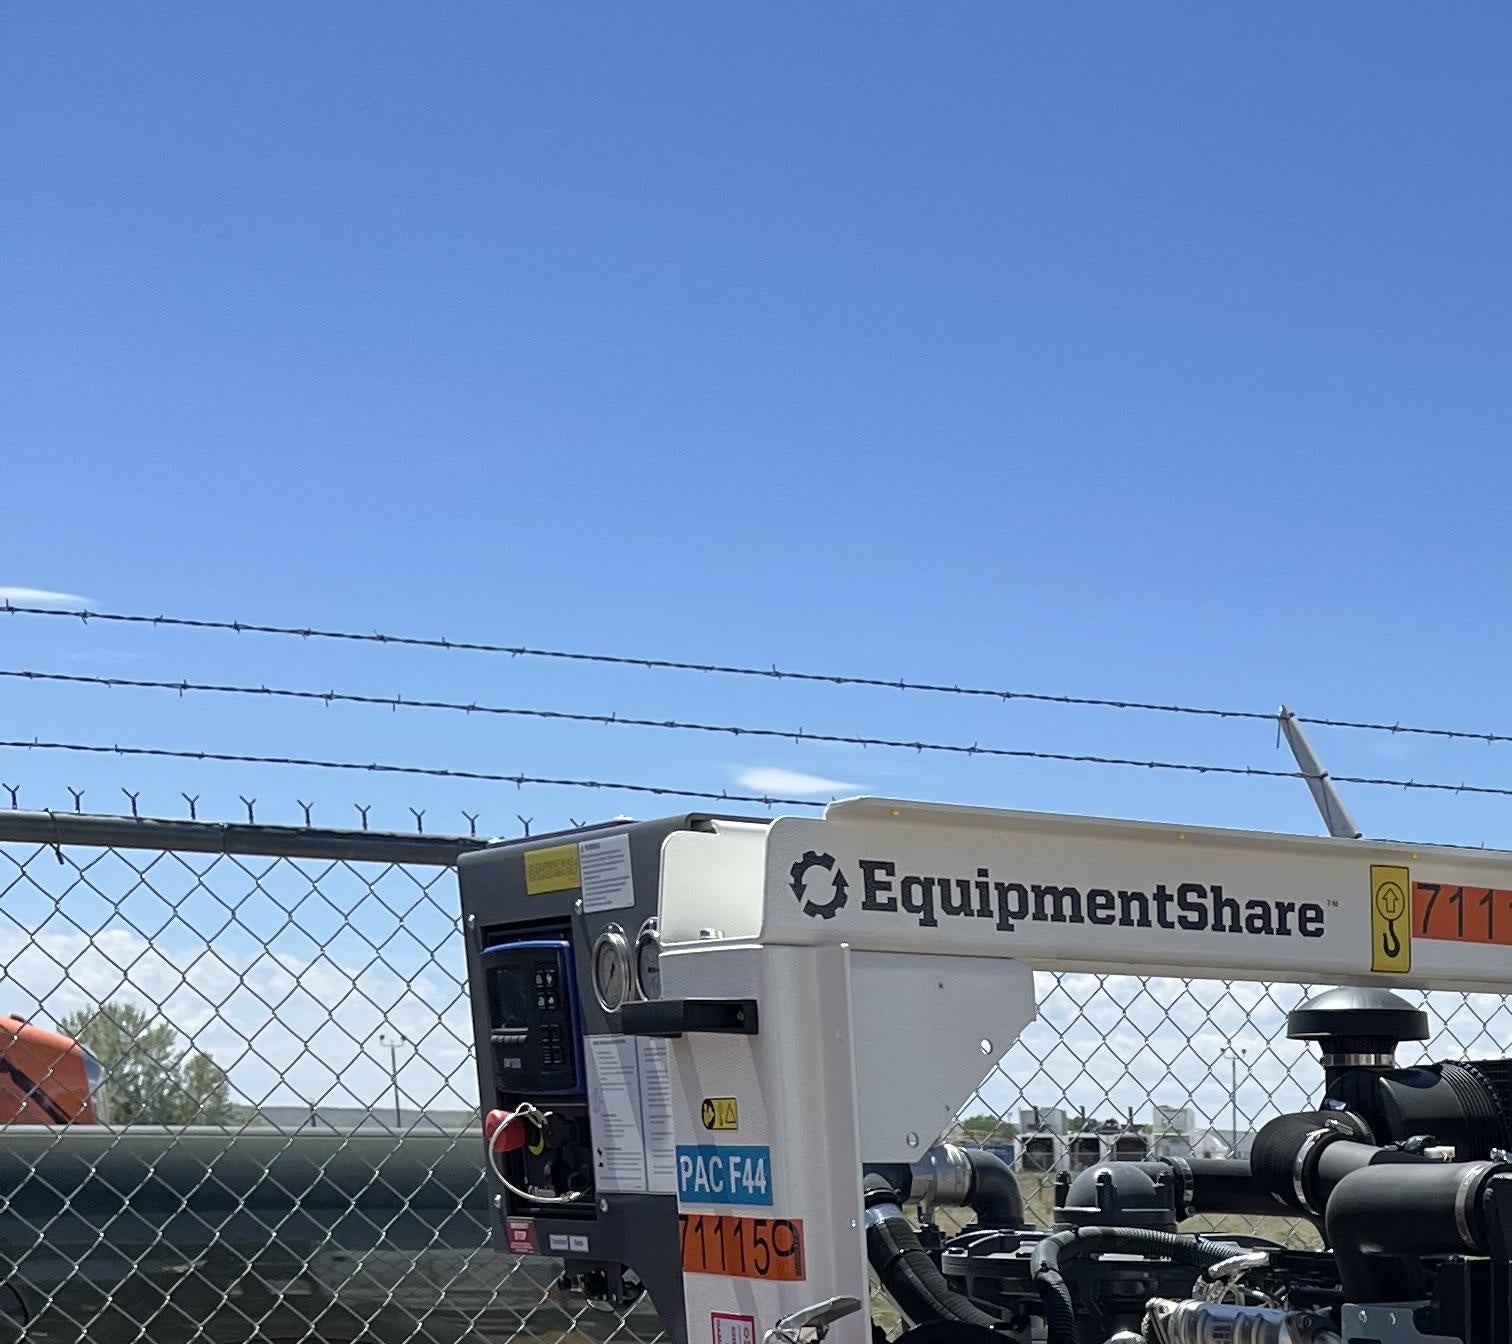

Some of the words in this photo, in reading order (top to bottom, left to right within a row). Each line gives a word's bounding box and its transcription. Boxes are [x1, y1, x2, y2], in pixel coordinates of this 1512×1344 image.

[858, 859, 1325, 937] EquipmentShare
[679, 1154, 724, 1193] PAC
[728, 1156, 767, 1195] F44
[678, 1214, 802, 1277] 711159
